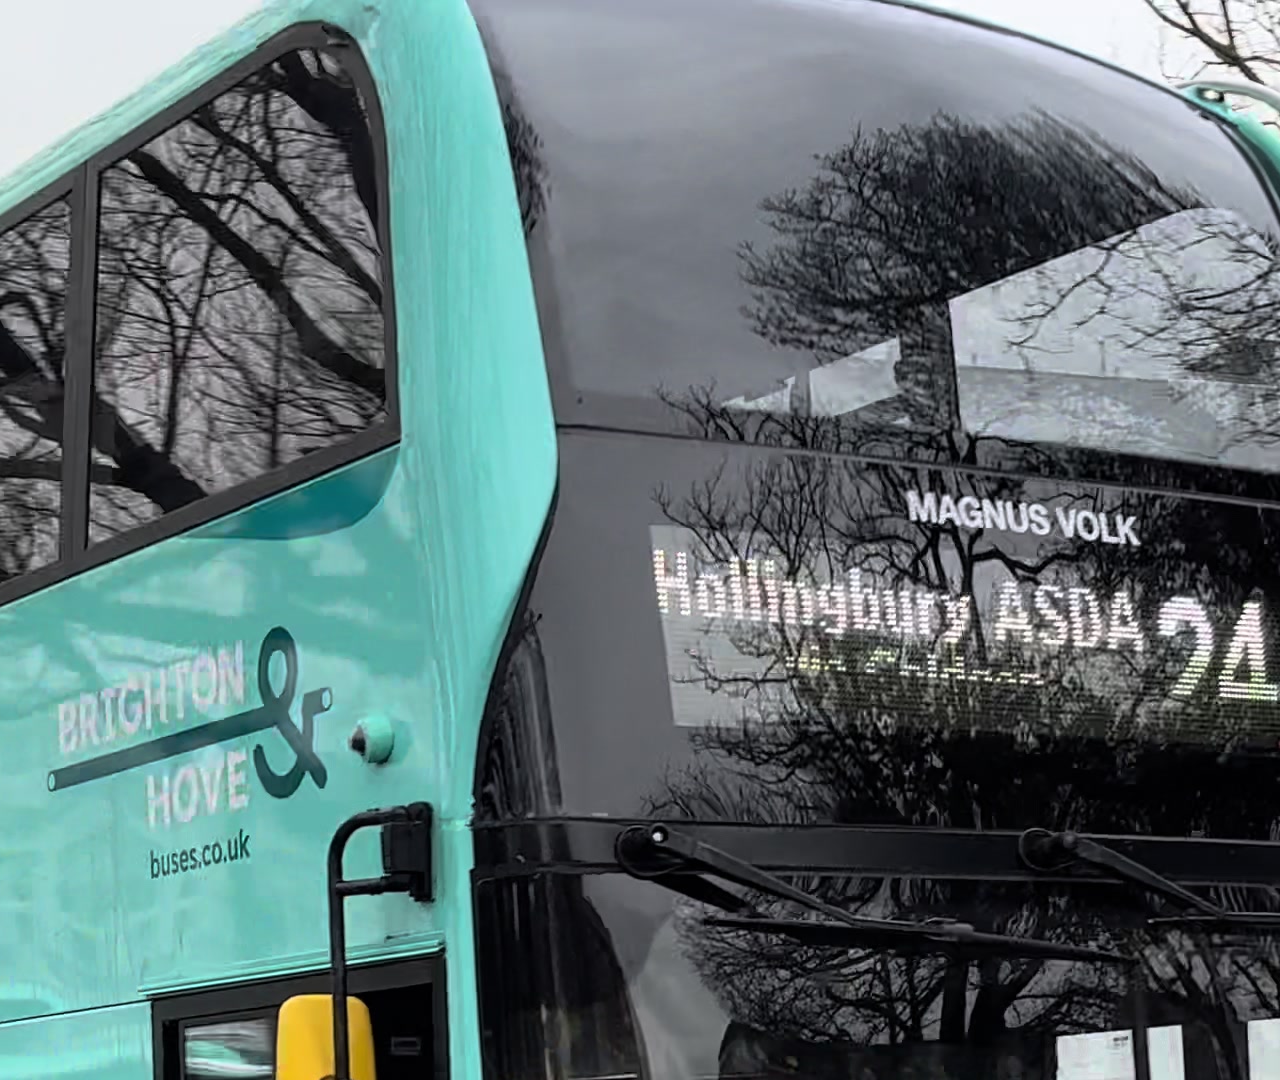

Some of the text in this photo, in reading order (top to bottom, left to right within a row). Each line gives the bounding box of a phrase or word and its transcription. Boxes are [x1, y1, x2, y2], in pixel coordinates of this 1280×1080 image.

[906, 489, 1142, 546] MAGNUS VOLK
[653, 549, 1280, 700] Hollingbury ASDA 24
[57, 626, 334, 799] BRIGHTON &
[145, 748, 251, 830] HOVE
[149, 828, 252, 879] buses.co.uk
